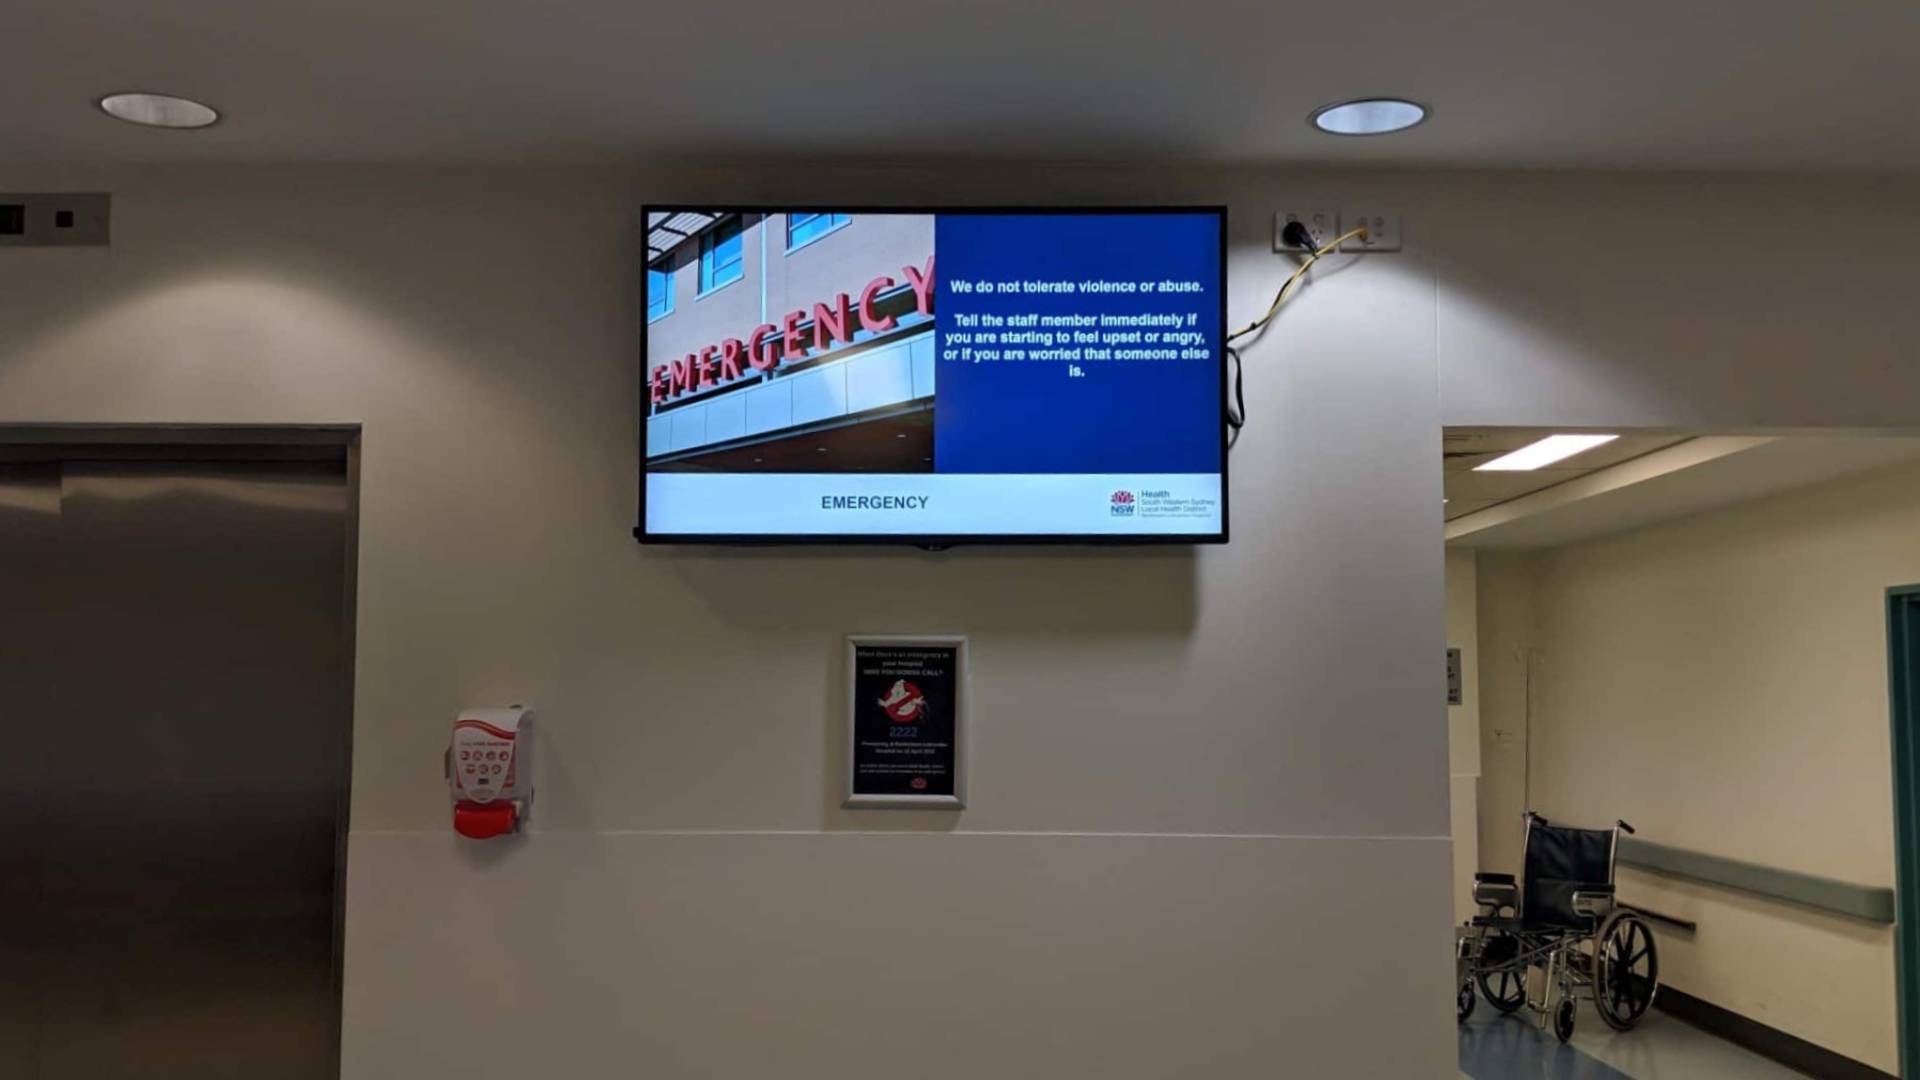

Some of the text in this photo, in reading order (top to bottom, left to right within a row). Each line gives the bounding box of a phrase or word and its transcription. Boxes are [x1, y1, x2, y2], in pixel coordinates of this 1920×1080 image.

[950, 280, 1204, 293] We do not tolerate violence or abuse.
[954, 314, 1197, 329] Tell the staff member immediately if
[652, 256, 935, 404] EMERGENCY
[945, 331, 1205, 346] you are starting to feel upset or angry,
[943, 348, 1210, 363] or if you are worried that someone else
[1068, 364, 1086, 377] is.
[1141, 490, 1170, 498] Health
[821, 495, 929, 510] EMERGENCY
[1110, 505, 1135, 514] NSW
